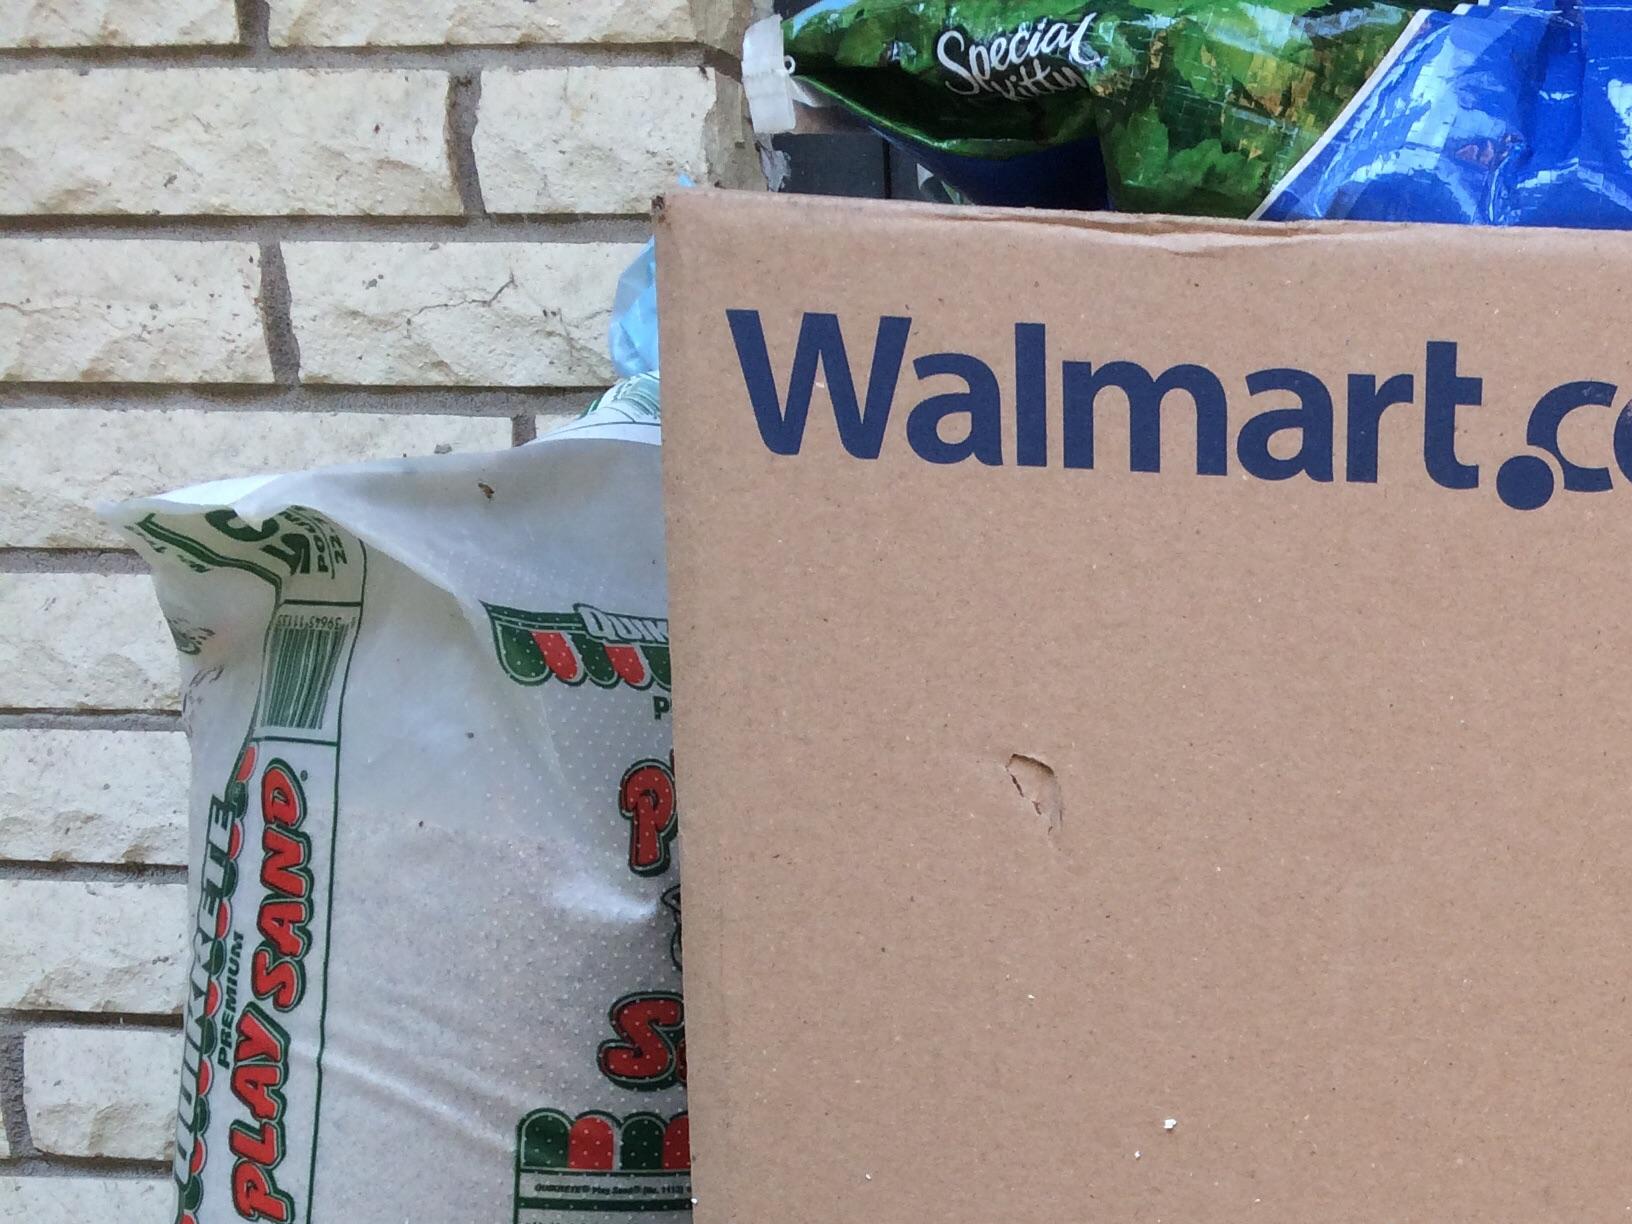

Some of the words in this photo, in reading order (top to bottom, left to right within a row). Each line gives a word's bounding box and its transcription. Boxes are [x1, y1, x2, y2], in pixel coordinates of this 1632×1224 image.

[936, 12, 1102, 95] Special
[250, 758, 313, 1013] SAND
[217, 931, 244, 1071] PREMIUM
